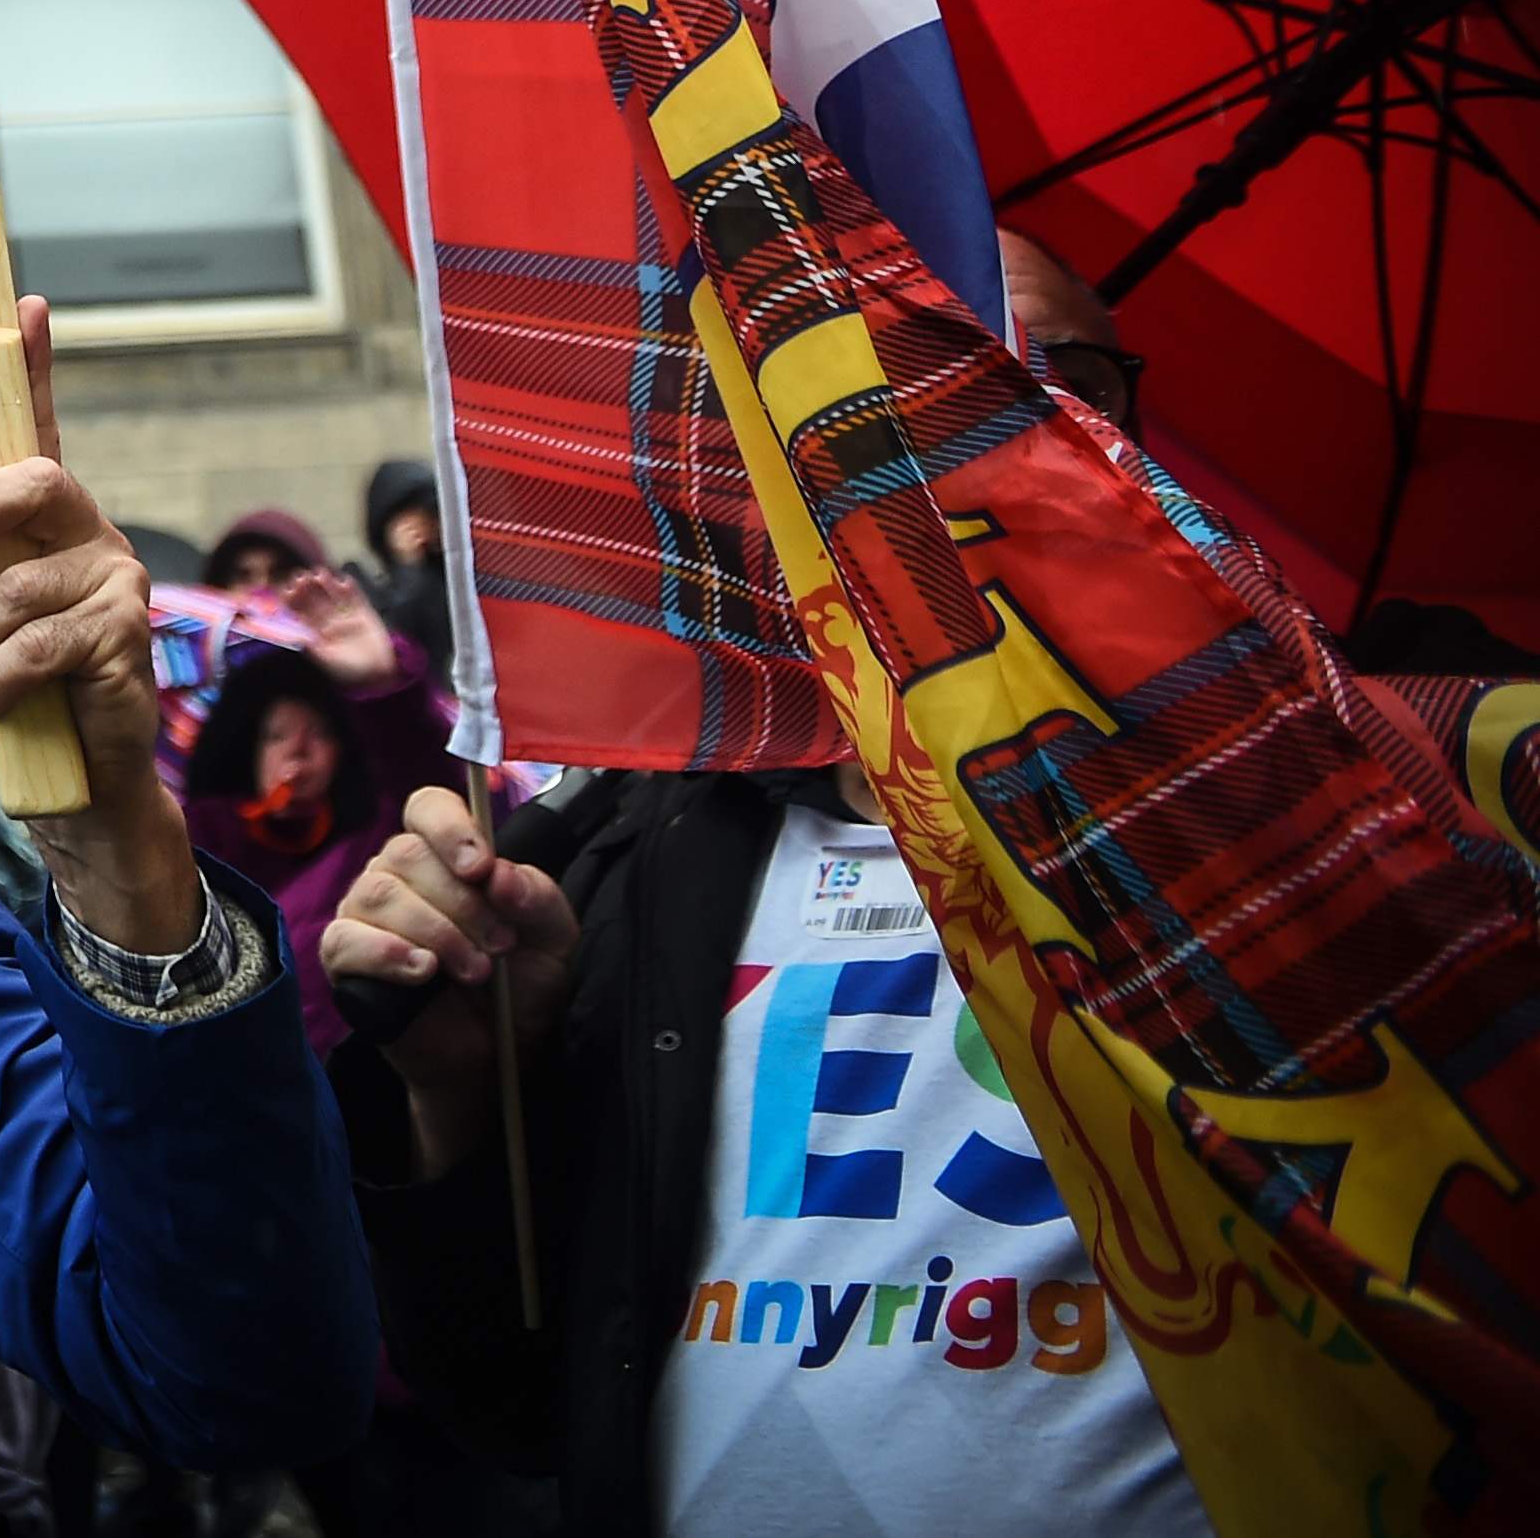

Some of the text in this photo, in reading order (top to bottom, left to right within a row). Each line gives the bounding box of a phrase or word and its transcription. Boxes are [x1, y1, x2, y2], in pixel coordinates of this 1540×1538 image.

[817, 861, 863, 889] YES
[722, 952, 1071, 1226] ES
[684, 1255, 1106, 1376] nnyrigg
